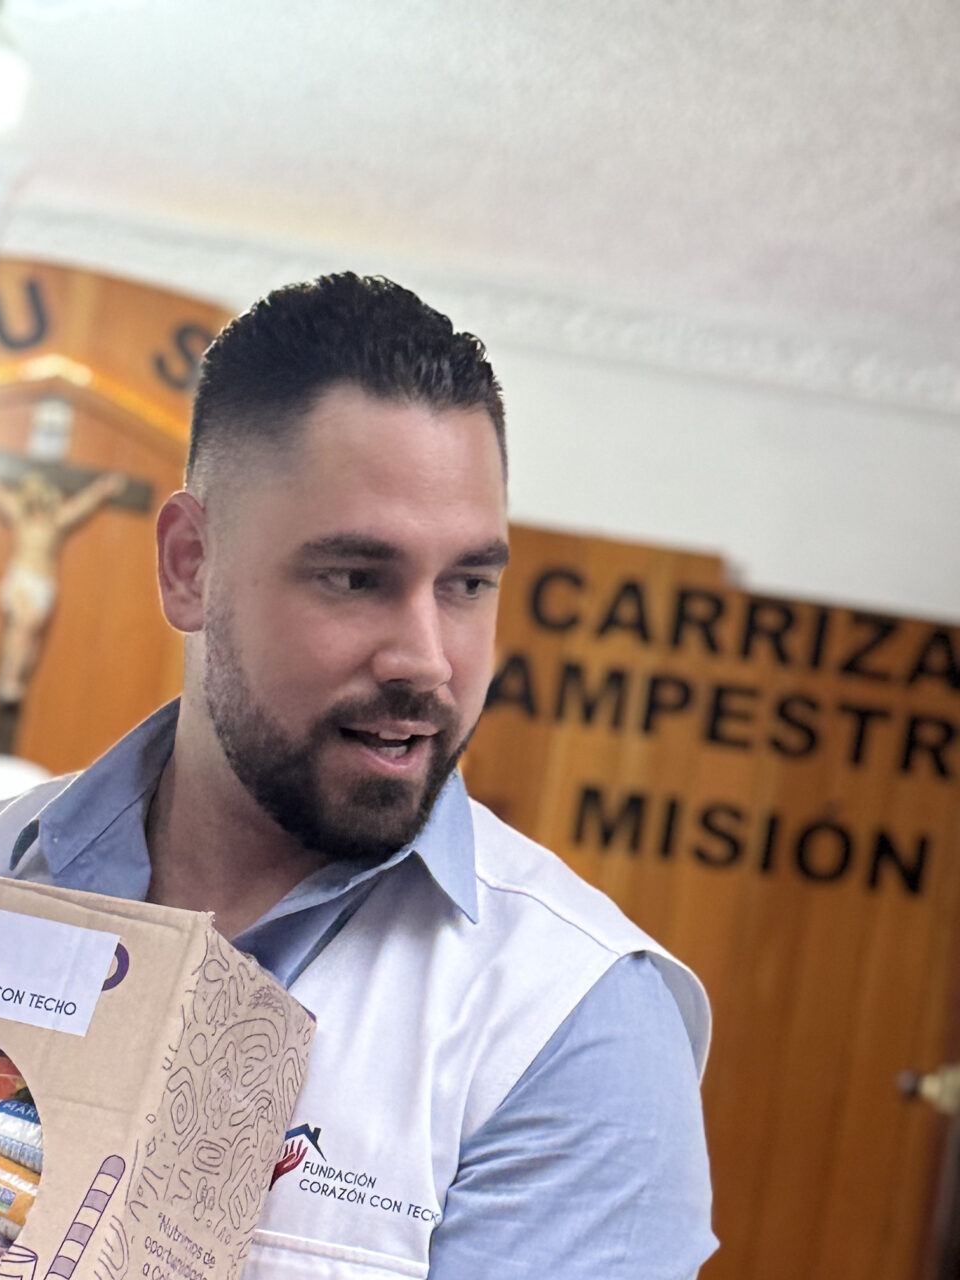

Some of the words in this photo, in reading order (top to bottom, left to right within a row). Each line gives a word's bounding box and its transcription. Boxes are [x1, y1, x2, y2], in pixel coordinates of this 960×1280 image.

[528, 568, 960, 691] CARRIZA
[571, 784, 930, 897] MISIÓN
[28, 993, 77, 1016] TECHO
[302, 1161, 377, 1189] FUNDACIÓN
[299, 1178, 366, 1205] CORAZÓN
[369, 1195, 402, 1213] CON
